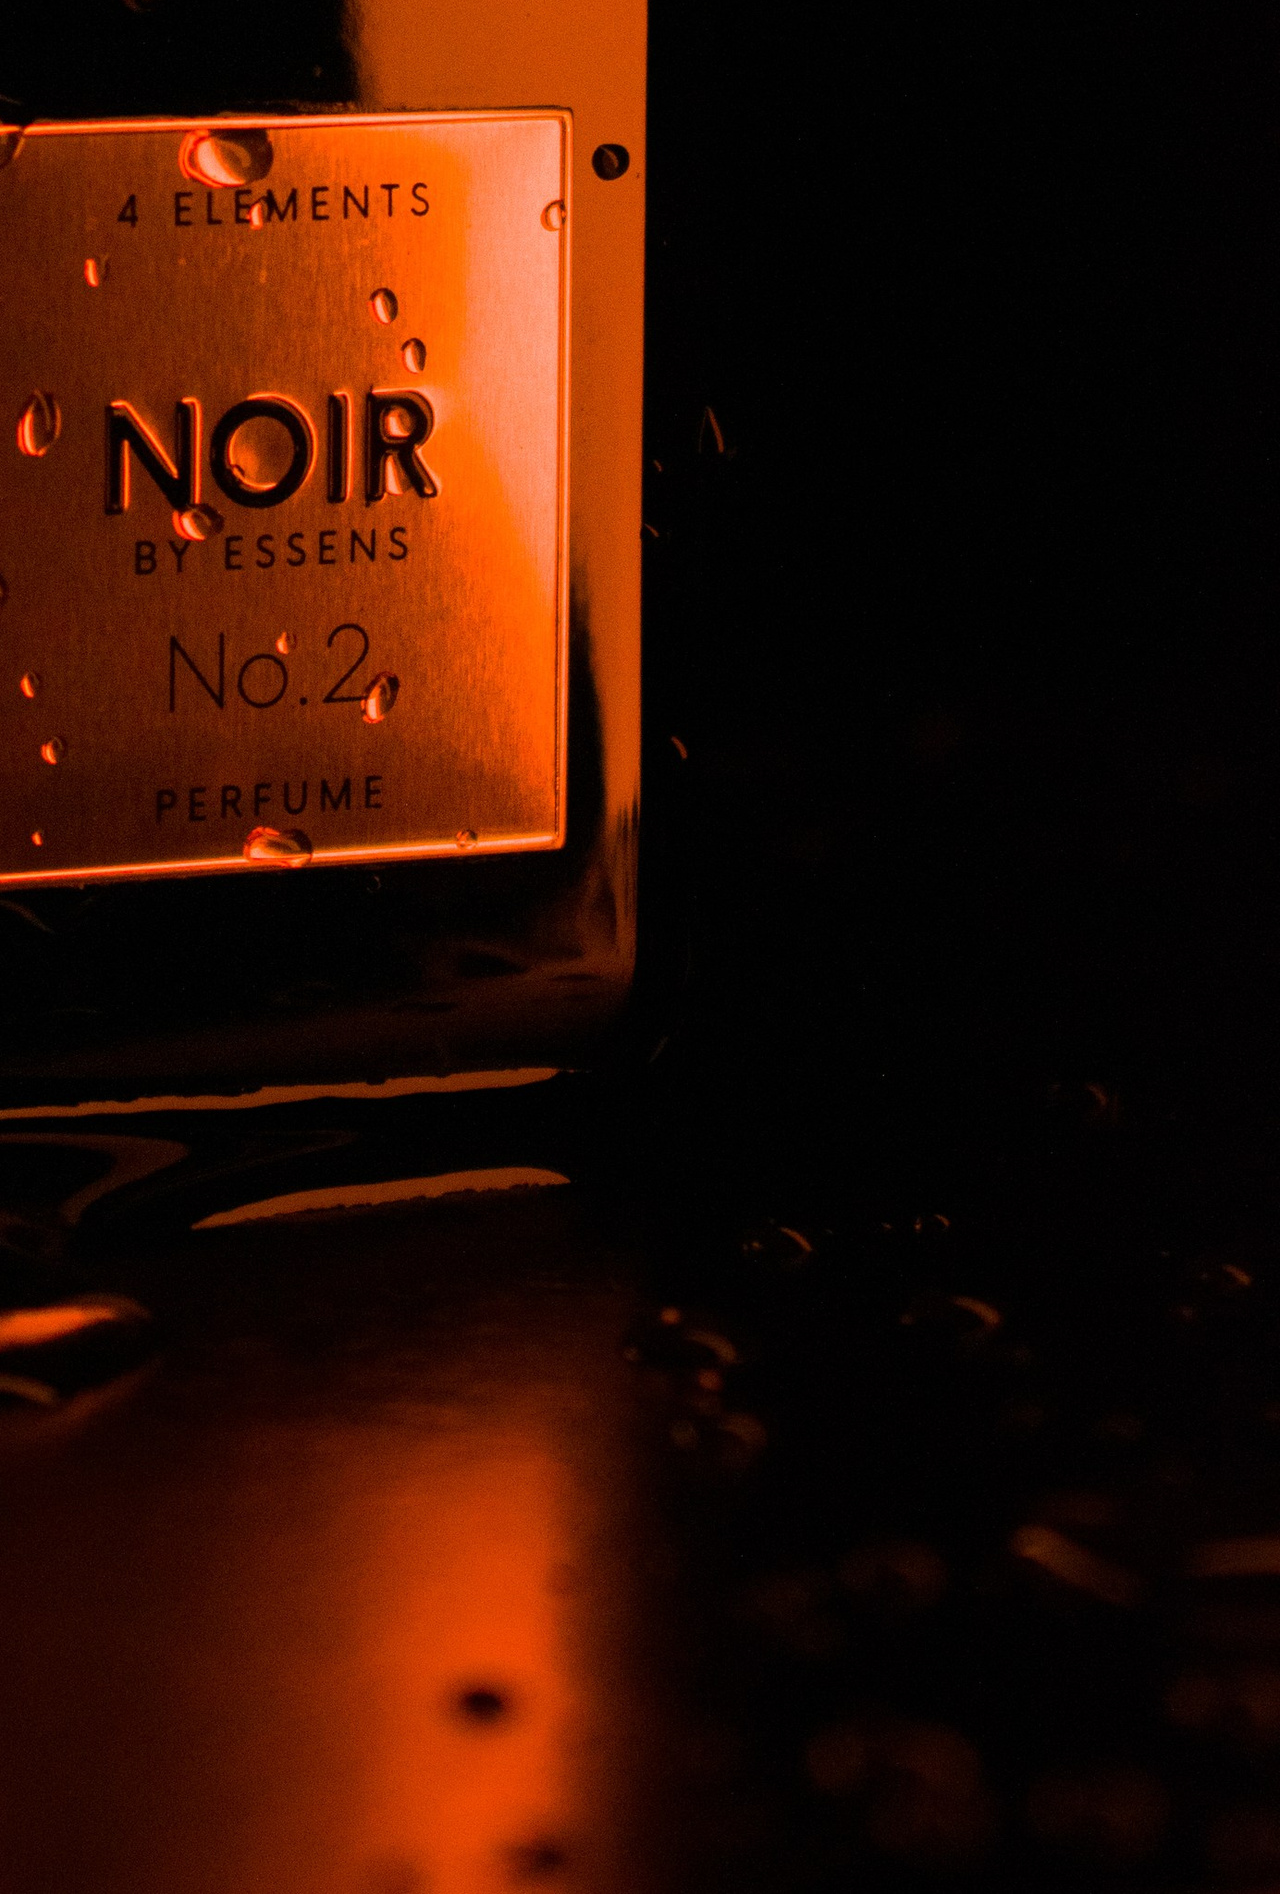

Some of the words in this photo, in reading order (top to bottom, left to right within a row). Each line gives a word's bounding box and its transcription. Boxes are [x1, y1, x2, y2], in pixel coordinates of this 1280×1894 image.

[117, 194, 139, 228] 4
[174, 183, 430, 227] ELEMENTS
[104, 389, 440, 515] NOIR
[134, 539, 191, 576] BY
[224, 526, 409, 571] ESSENS
[155, 774, 384, 824] PERFUME
